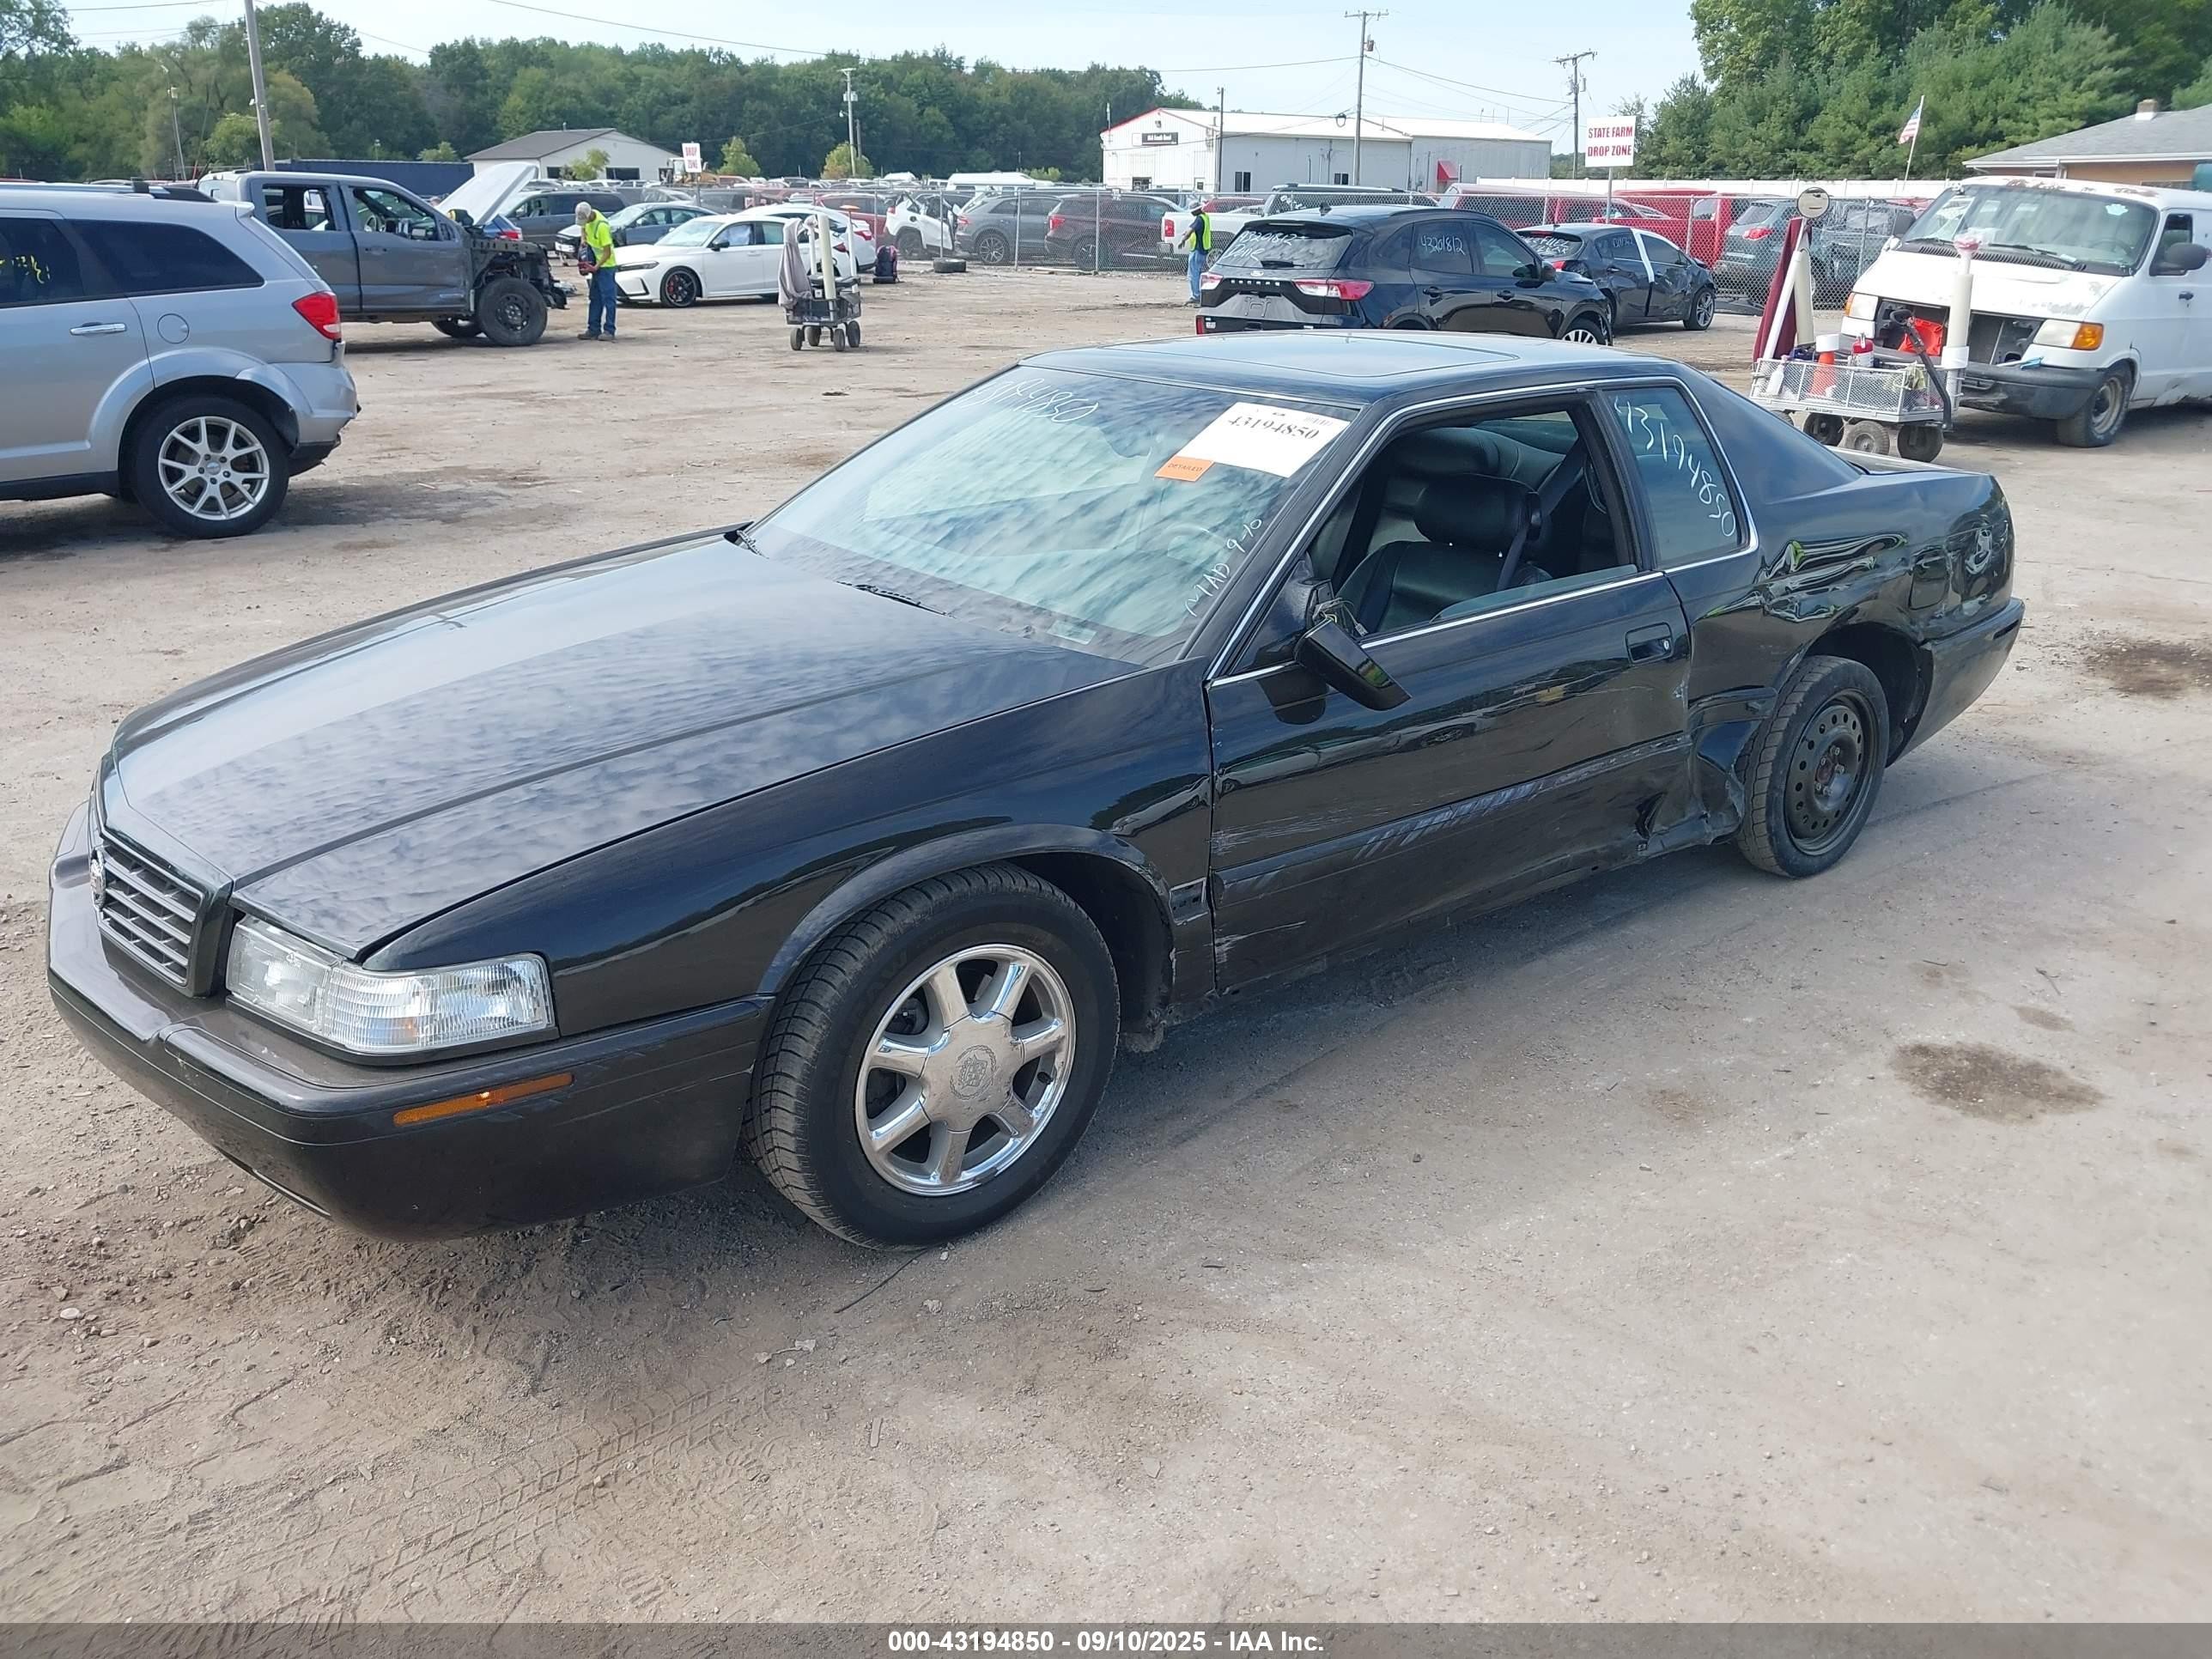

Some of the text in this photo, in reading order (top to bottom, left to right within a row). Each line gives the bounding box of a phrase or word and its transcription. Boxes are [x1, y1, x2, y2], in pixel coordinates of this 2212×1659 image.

[1588, 125, 1633, 138] STATE FARM
[1588, 145, 1632, 157] DROP ZONE
[1420, 234, 1466, 256] 43201812
[1228, 415, 1321, 441] 43194850
[1613, 396, 1736, 537] 43194850
[1226, 518, 1262, 553] 9-10
